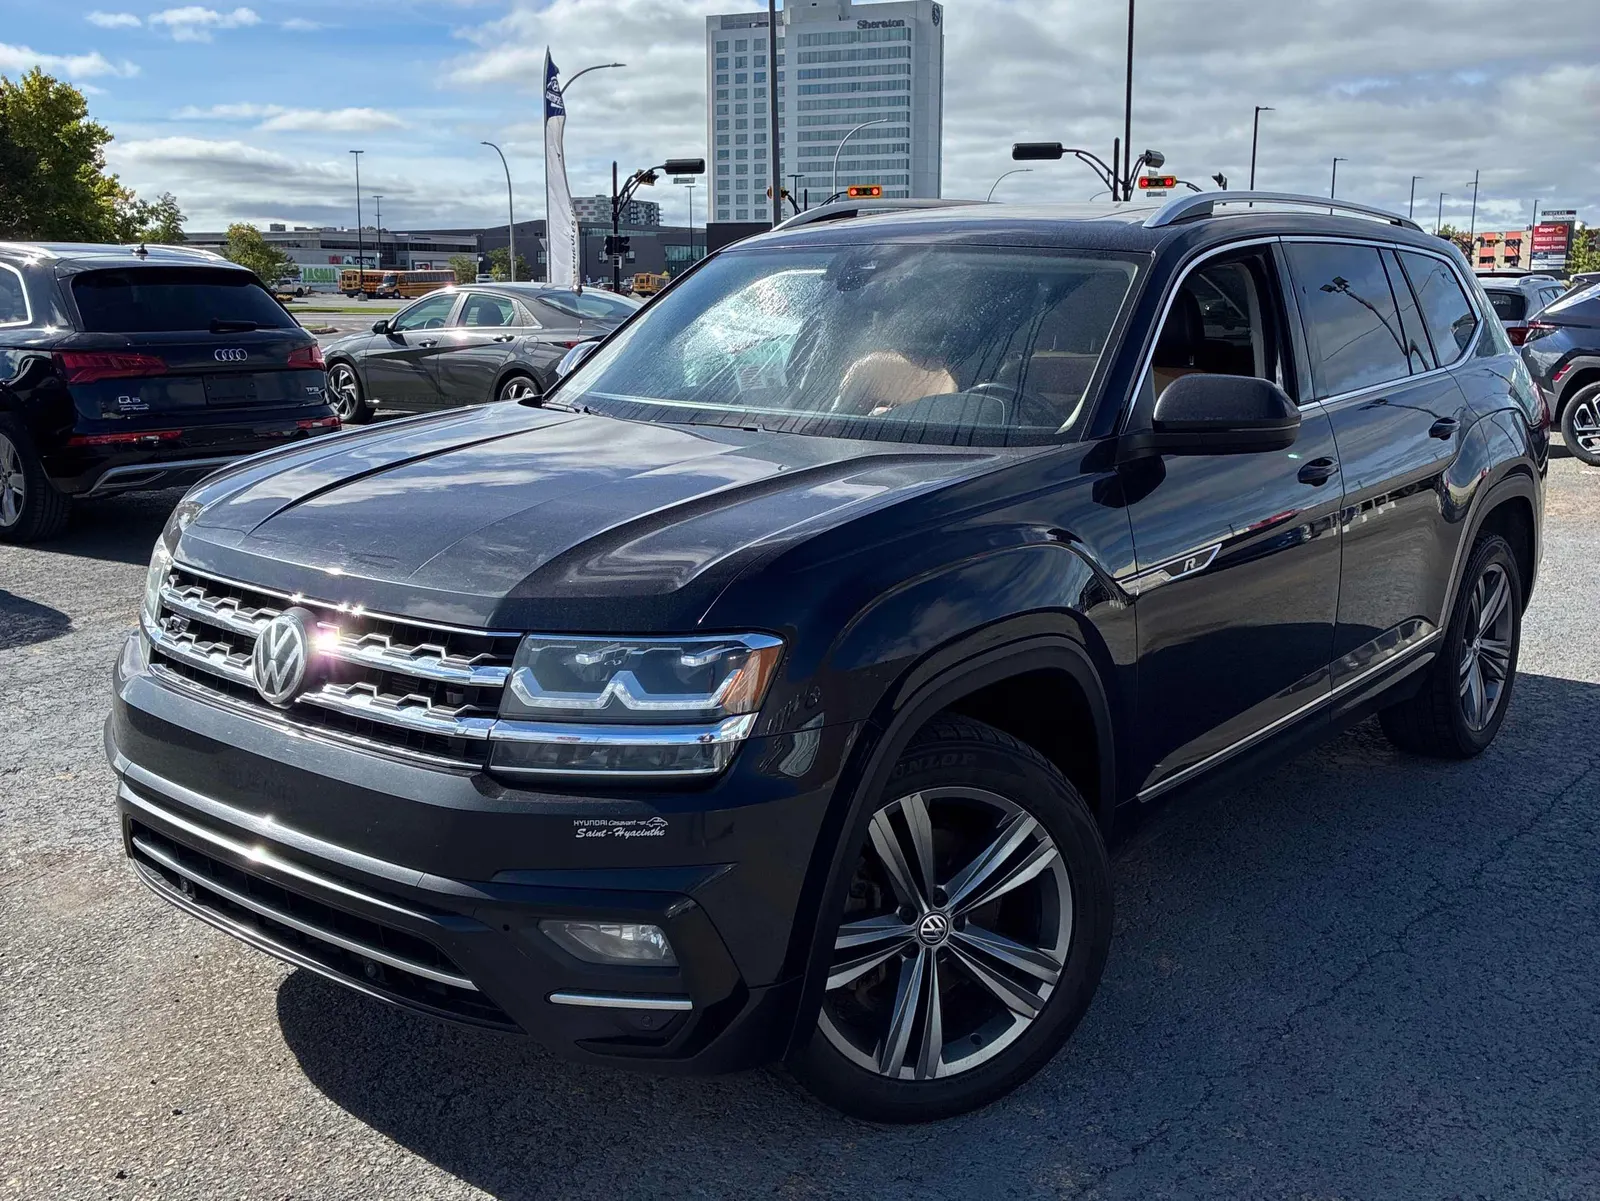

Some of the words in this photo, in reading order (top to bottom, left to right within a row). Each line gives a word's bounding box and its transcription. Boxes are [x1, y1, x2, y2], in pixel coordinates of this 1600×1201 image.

[857, 18, 905, 30] Sheraton
[1556, 226, 1563, 234] C
[1184, 557, 1195, 571] R
[575, 826, 665, 839] Saint-Hyacinthe
